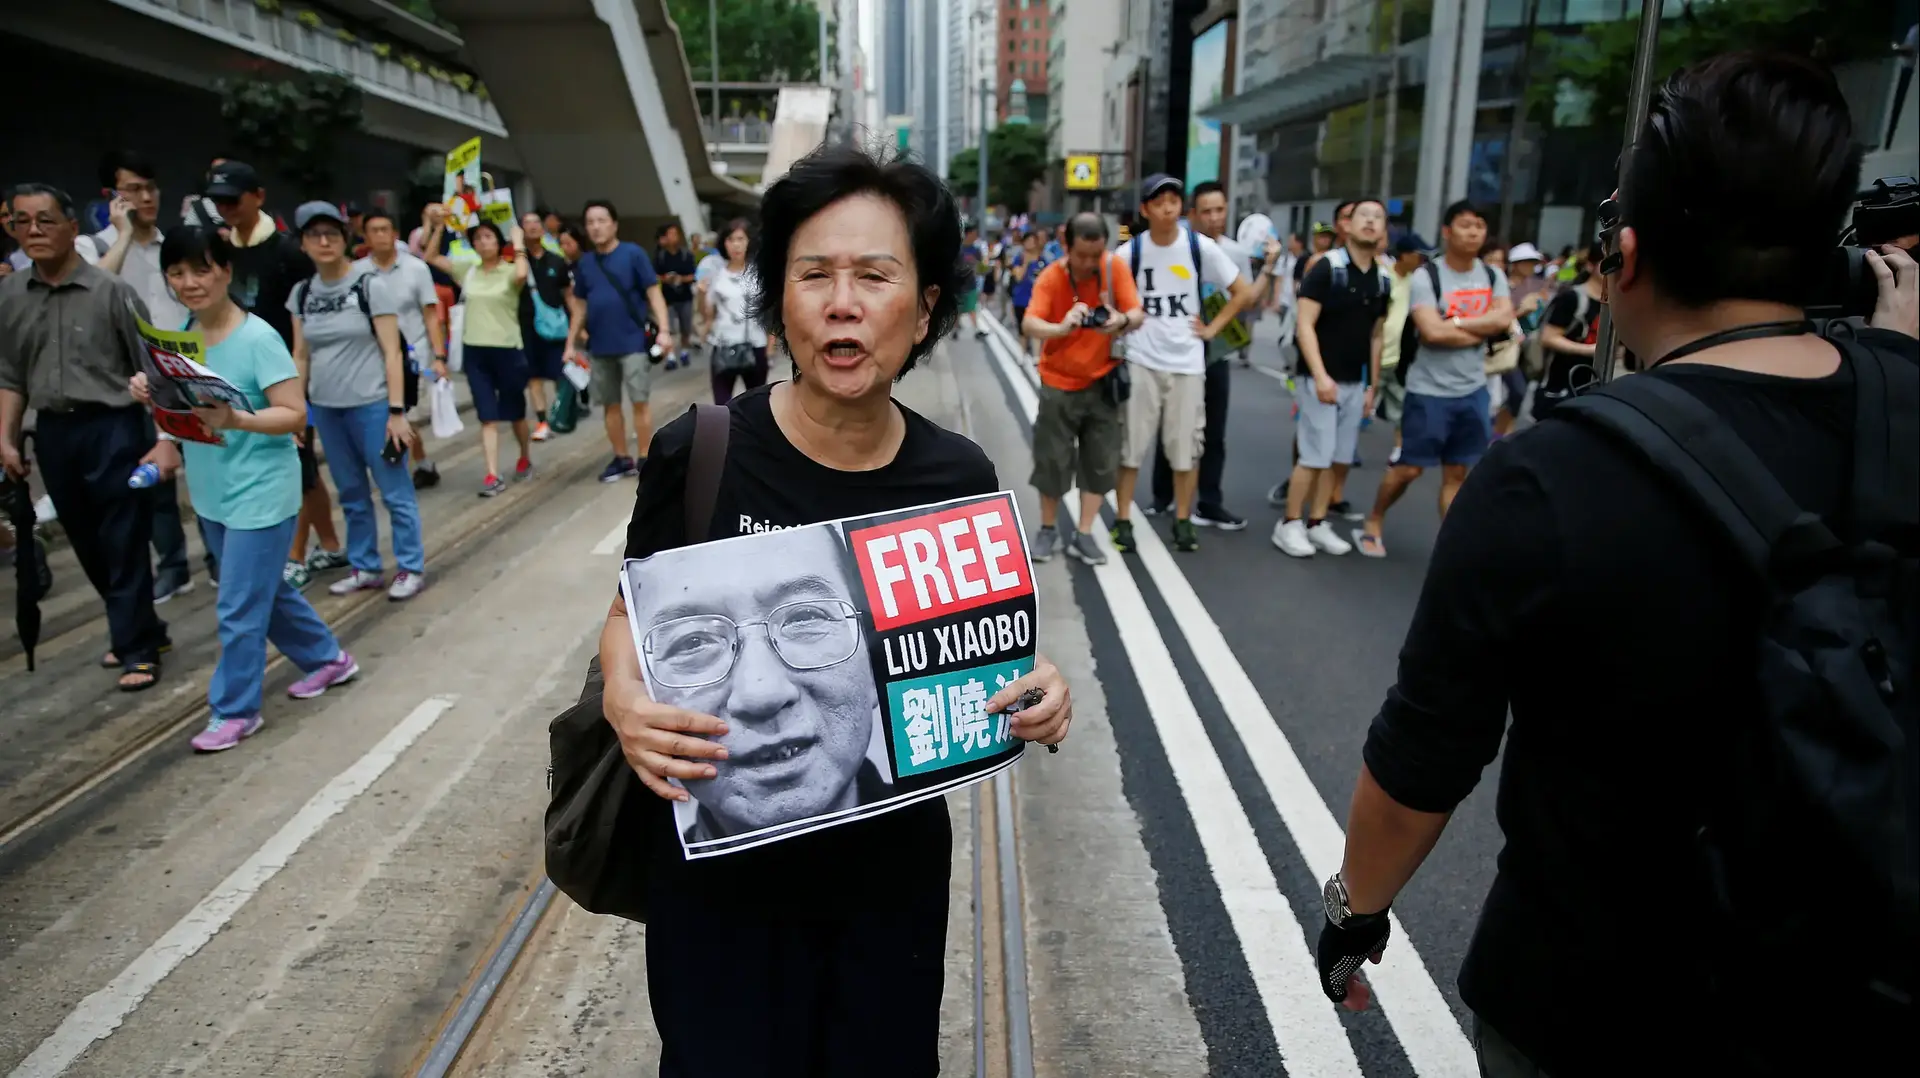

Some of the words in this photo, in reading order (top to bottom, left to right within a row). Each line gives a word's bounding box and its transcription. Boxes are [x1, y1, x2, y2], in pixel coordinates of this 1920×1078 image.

[1144, 268, 1155, 291] I
[1143, 294, 1189, 317] HK
[740, 513, 802, 534] Reje
[866, 511, 1020, 618] FREE
[883, 631, 928, 676] LIU
[933, 610, 1030, 665] XIAOBO
